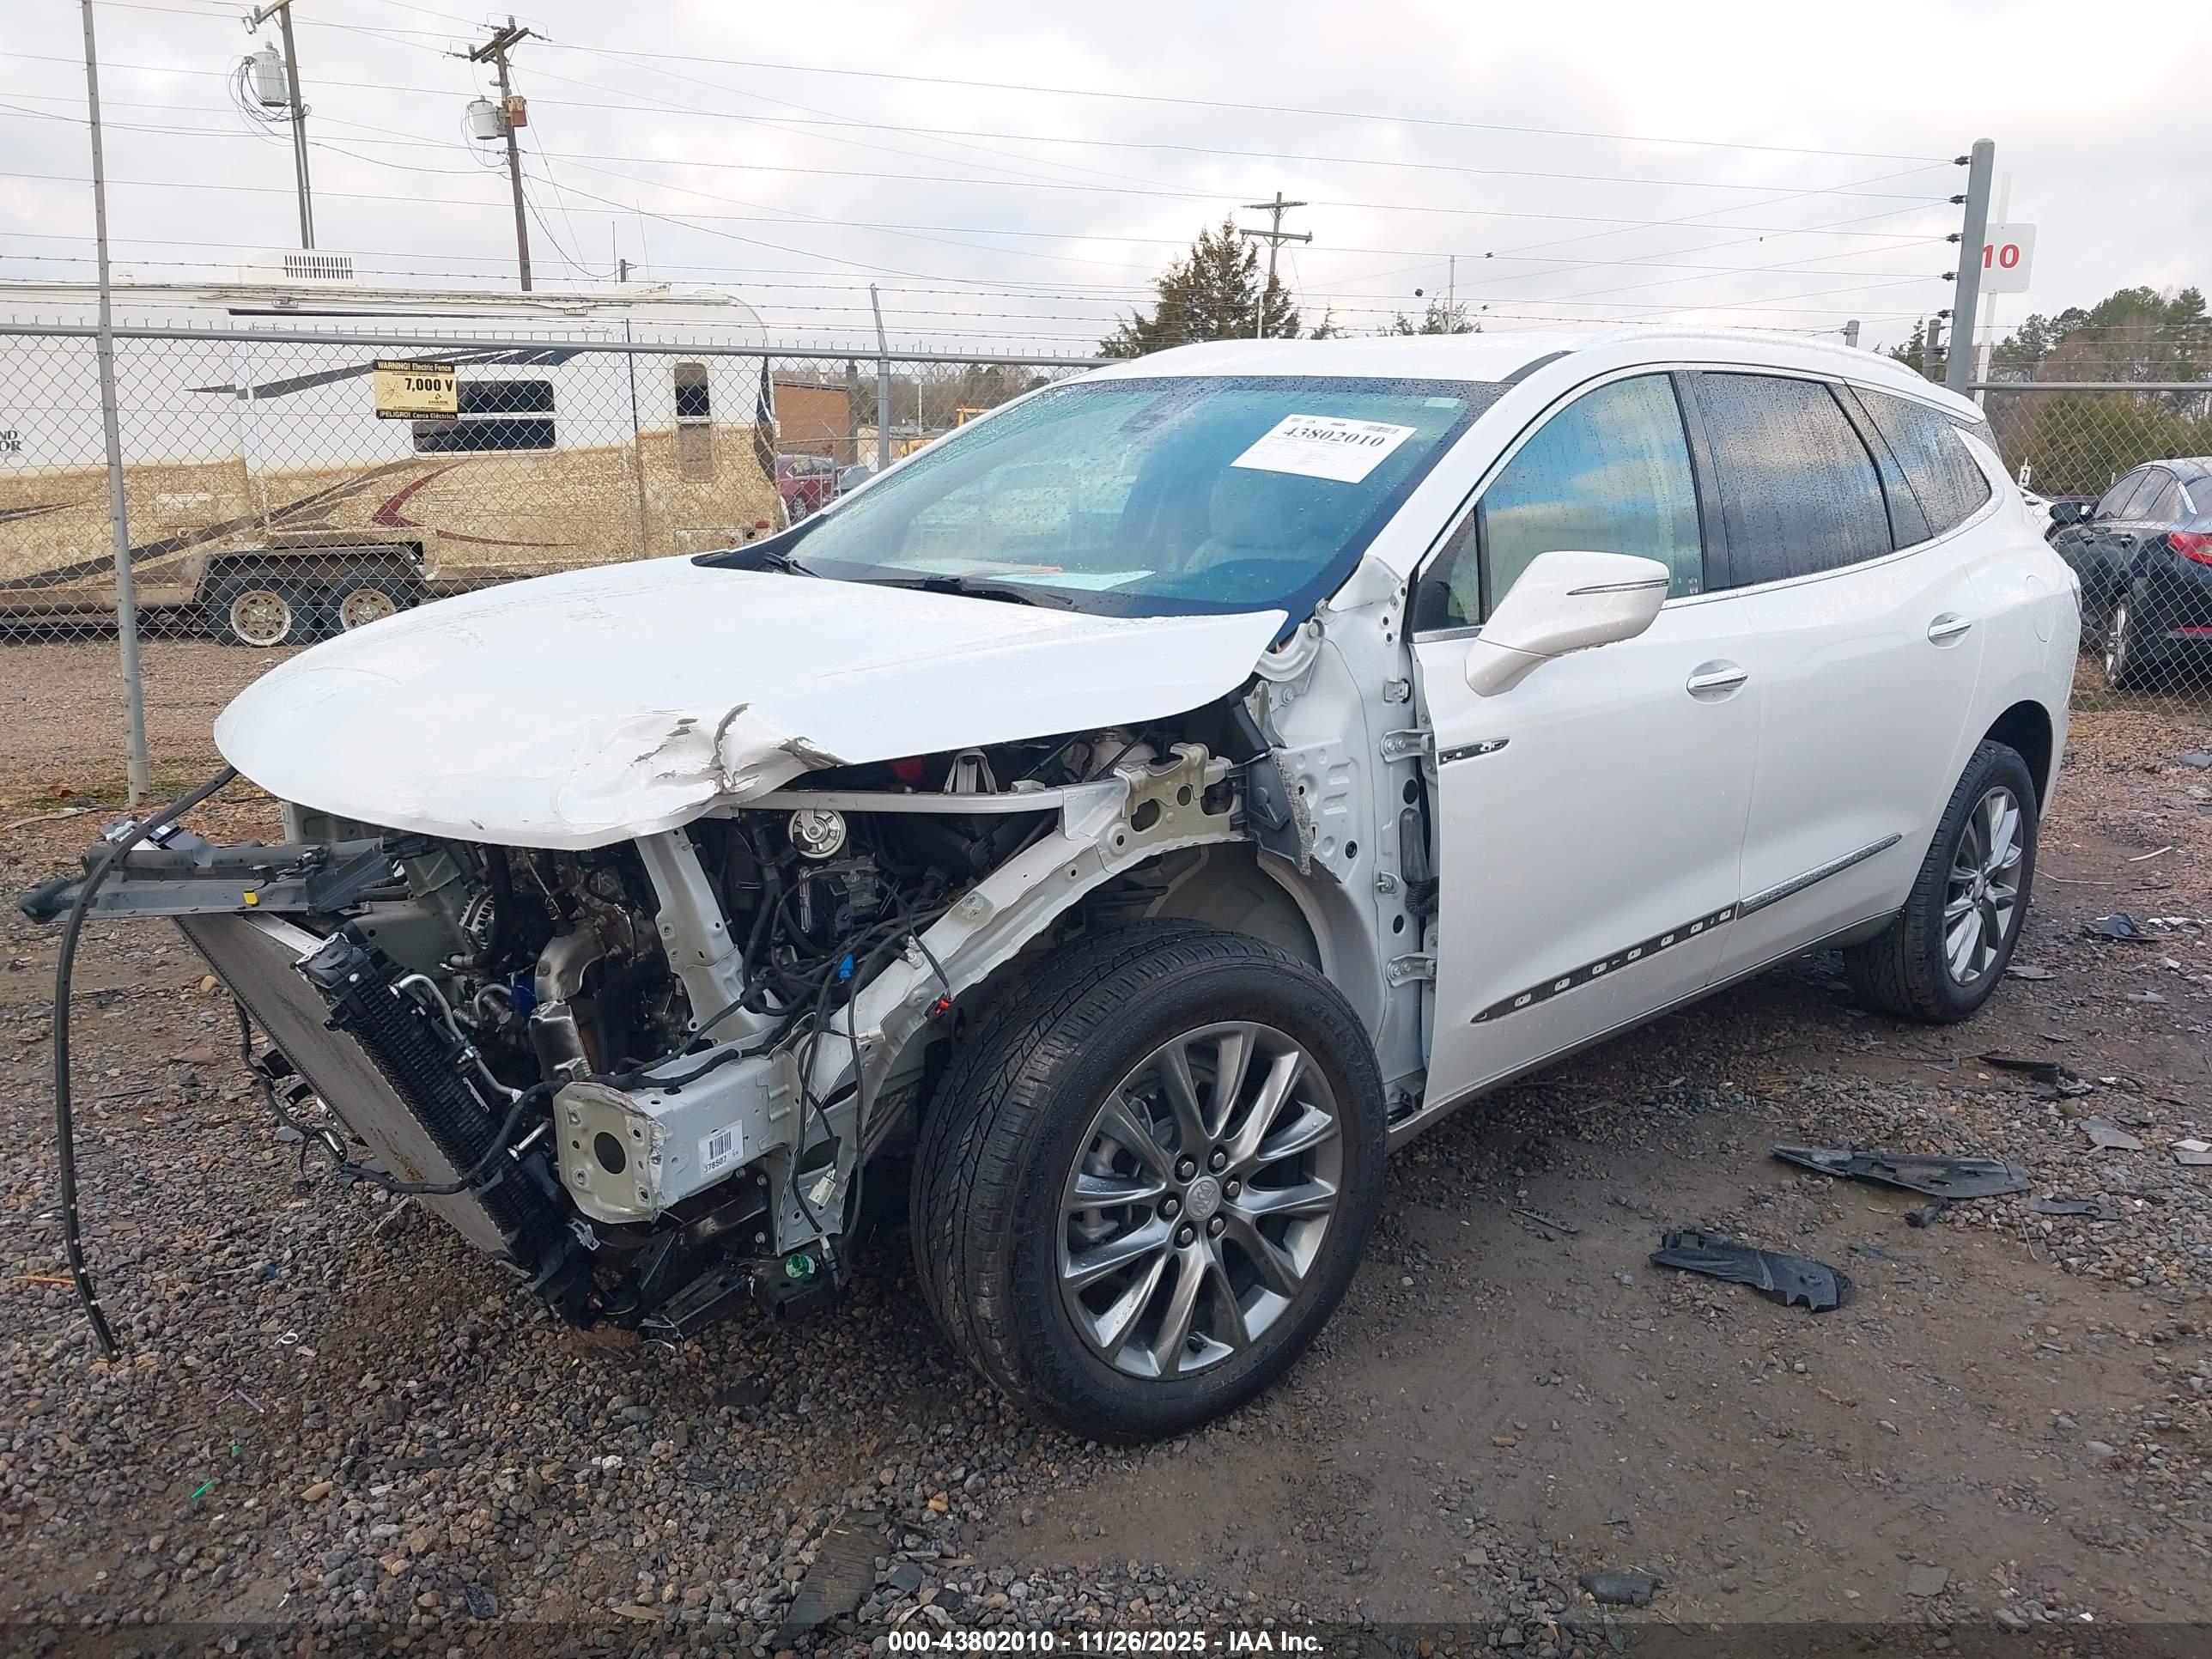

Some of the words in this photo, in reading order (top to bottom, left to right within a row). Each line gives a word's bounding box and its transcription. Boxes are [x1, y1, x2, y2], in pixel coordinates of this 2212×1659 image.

[1982, 244, 2020, 269] 10
[377, 361, 410, 371] WARNING!
[412, 362, 433, 372] Electric
[434, 363, 452, 372] Fence
[404, 377, 441, 392] 7,000
[445, 379, 453, 392] V
[1283, 427, 1386, 447] 43802010
